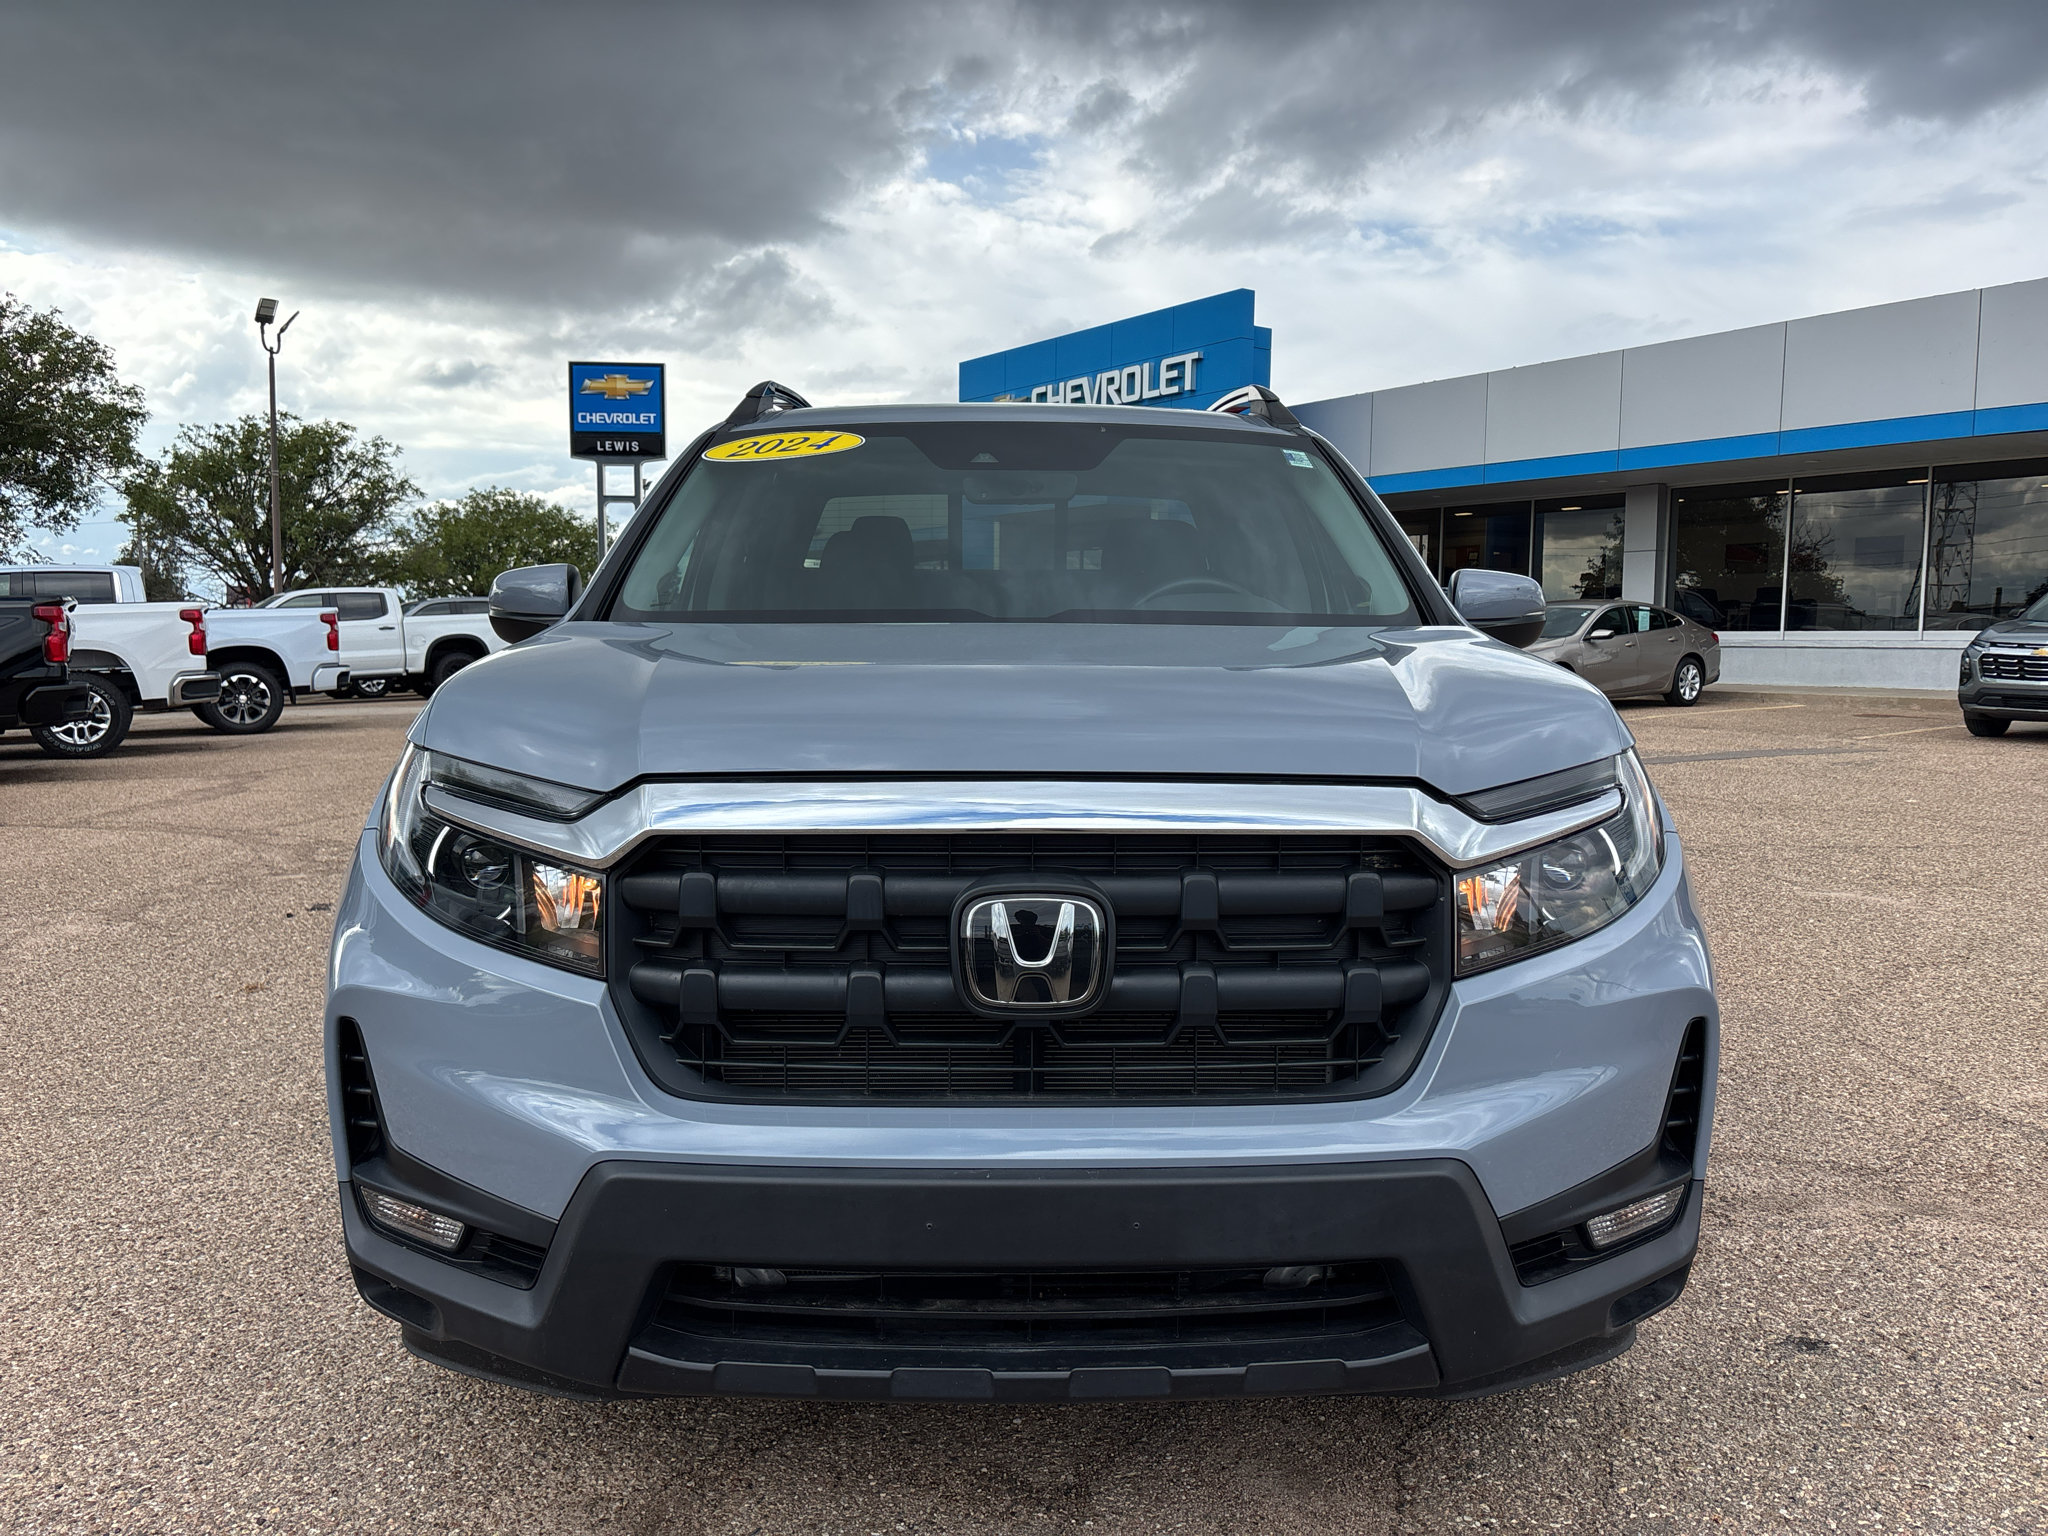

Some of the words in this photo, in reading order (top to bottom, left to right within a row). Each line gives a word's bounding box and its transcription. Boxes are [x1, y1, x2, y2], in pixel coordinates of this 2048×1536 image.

[1030, 351, 1203, 405] CHEVROLET
[577, 412, 656, 424] CHEVROLET
[597, 441, 640, 452] LEWIS
[725, 433, 843, 457] 2024
